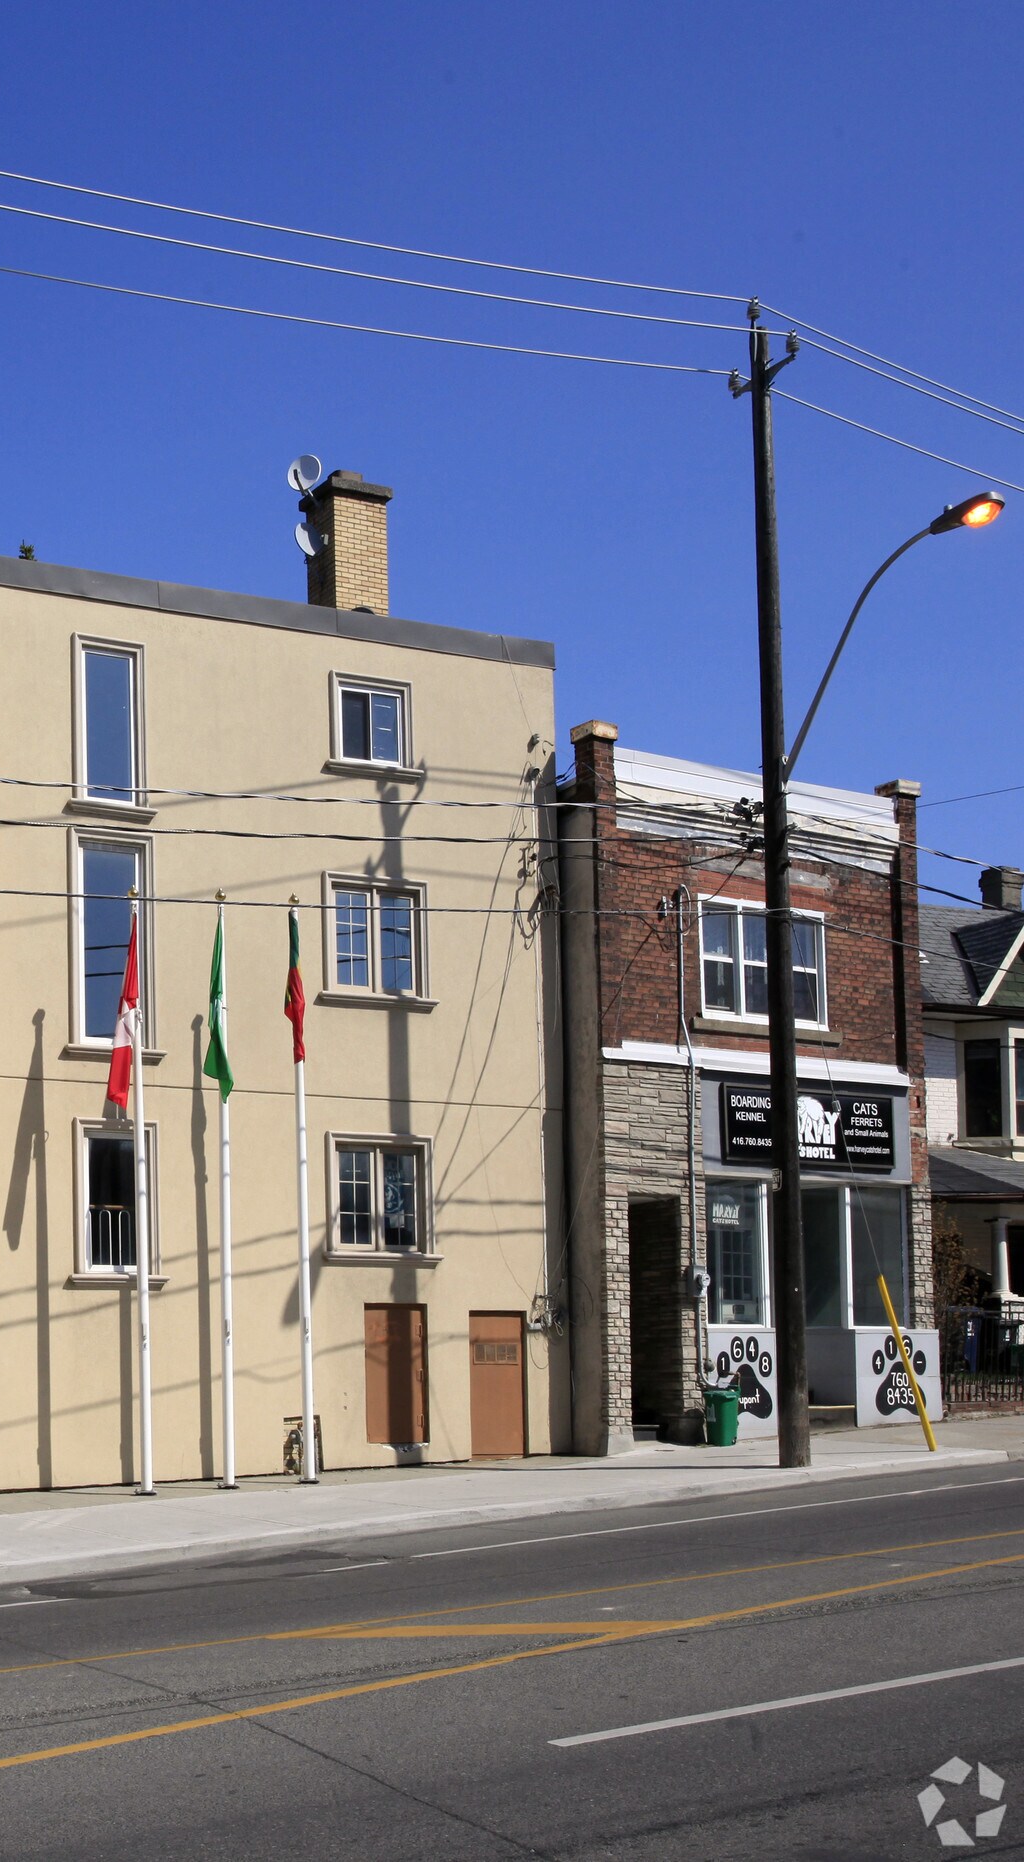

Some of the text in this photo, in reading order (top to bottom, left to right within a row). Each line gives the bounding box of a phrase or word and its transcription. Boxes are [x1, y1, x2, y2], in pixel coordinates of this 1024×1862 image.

[730, 1095, 771, 1109] BOARDING
[853, 1102, 878, 1115] CATS
[735, 1111, 767, 1122] KENNEL
[850, 1117, 883, 1127] FERRETS
[855, 1129, 869, 1137] Small
[869, 1130, 889, 1138] Animals
[732, 1137, 772, 1147] 416.760.8435
[891, 1372, 909, 1387] 760
[887, 1388, 915, 1405] 8435
